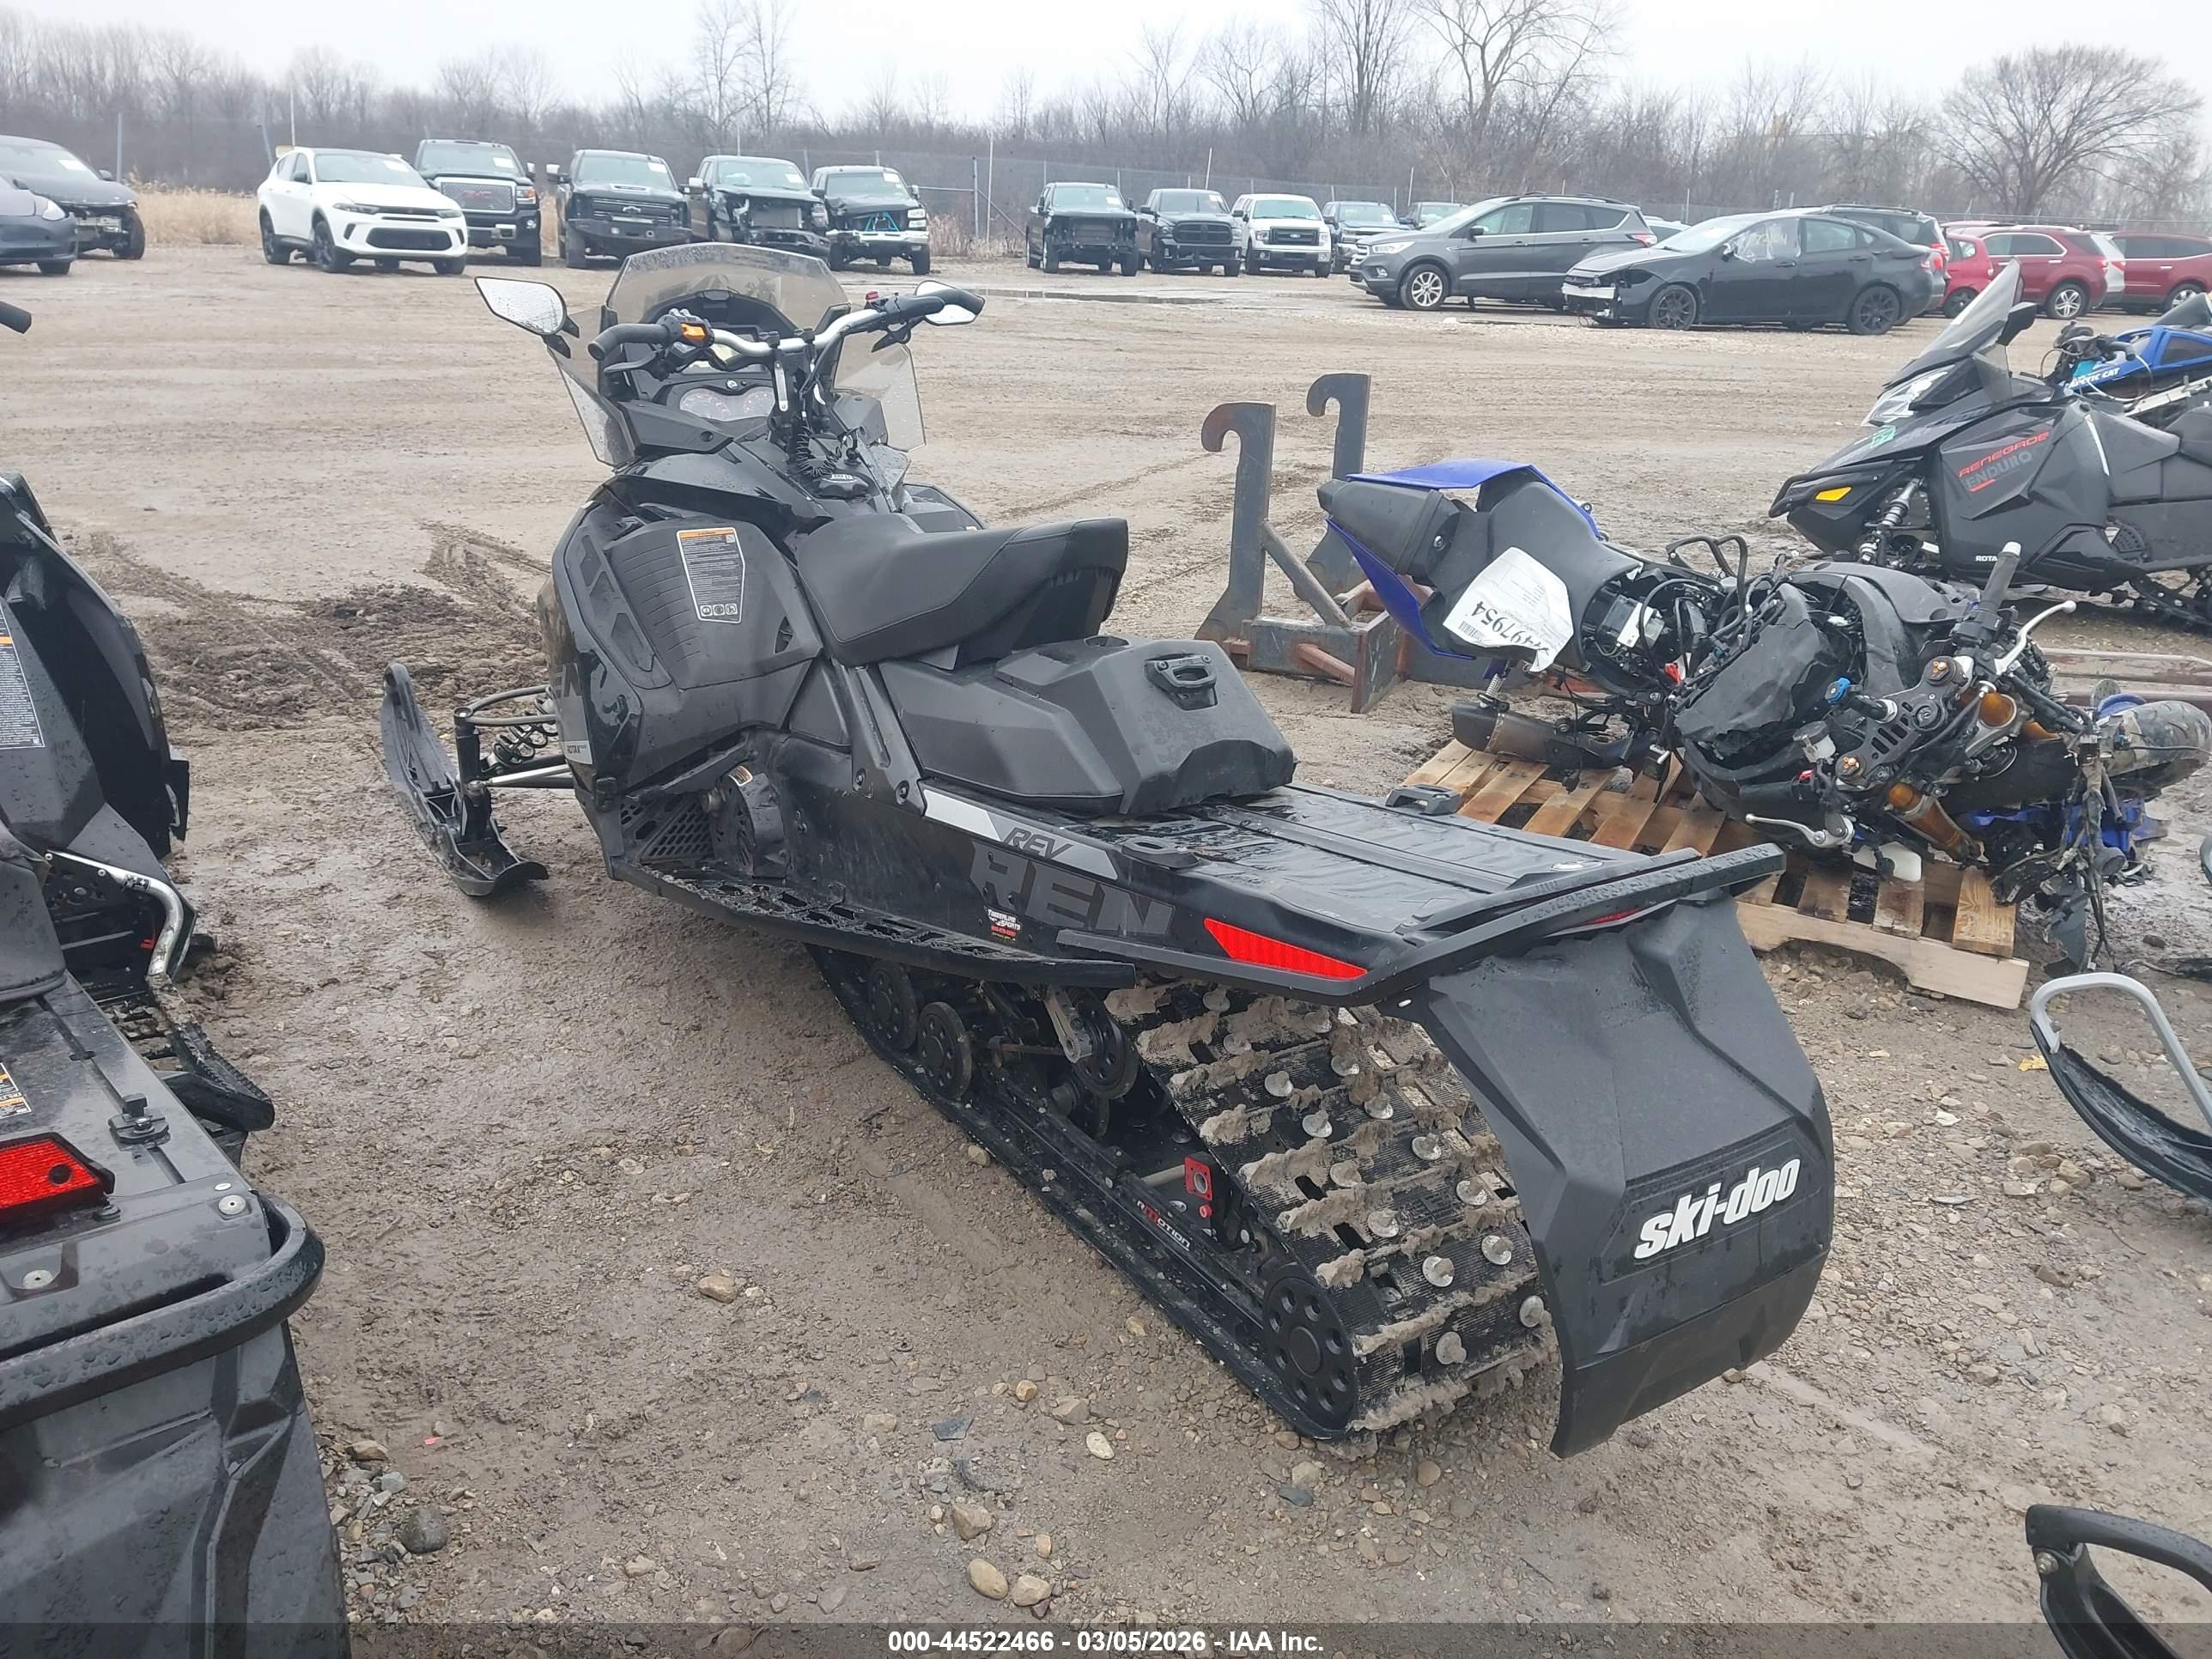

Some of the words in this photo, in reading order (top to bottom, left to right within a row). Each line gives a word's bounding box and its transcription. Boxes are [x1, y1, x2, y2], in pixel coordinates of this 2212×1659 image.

[2101, 367, 2121, 379] CAT
[1958, 431, 2051, 477] RENEGADE
[1964, 450, 2033, 489] ENDURO
[1001, 827, 1075, 860] REV
[1633, 1158, 1802, 1260] ski-doo
